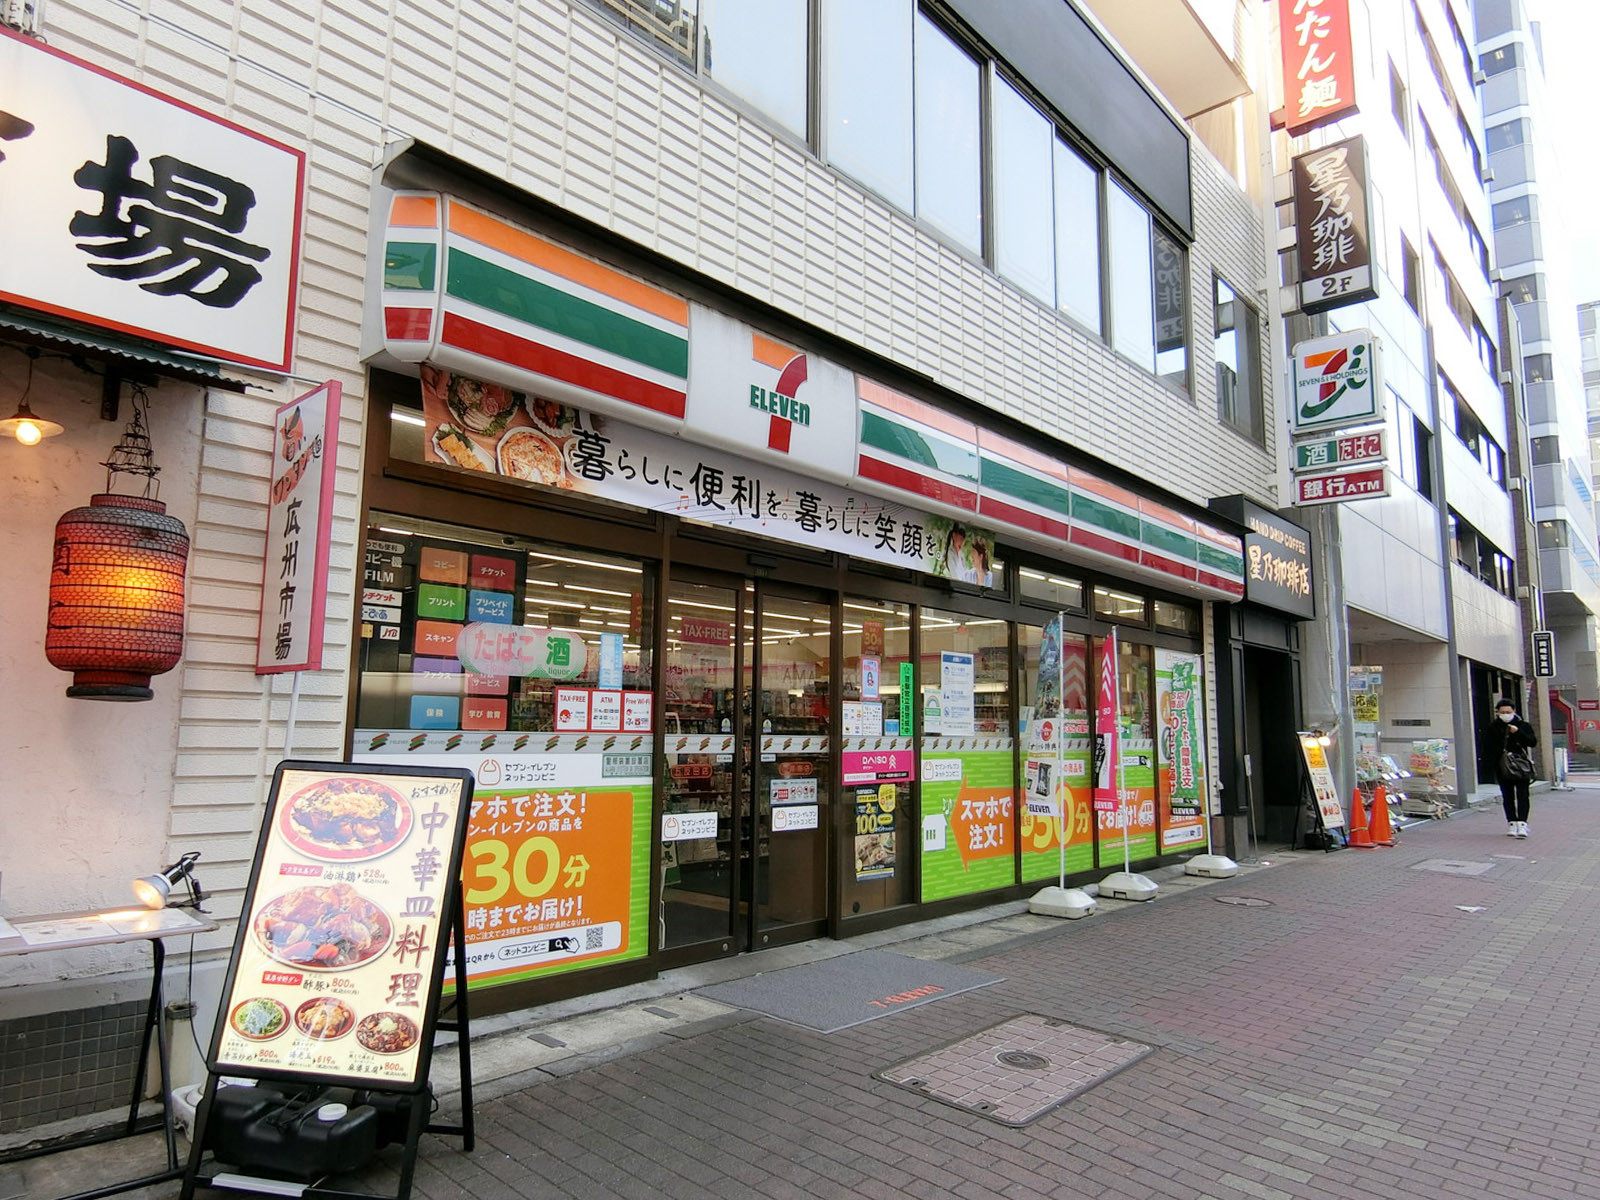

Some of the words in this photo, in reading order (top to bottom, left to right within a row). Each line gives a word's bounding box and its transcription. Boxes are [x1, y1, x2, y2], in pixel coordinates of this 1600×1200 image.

[1306, 147, 1355, 272] 星乃珈琲
[1322, 276, 1353, 298] 2F
[1330, 367, 1369, 382] HOLDINGS
[1306, 443, 1328, 466] 酒
[1340, 435, 1380, 461] たばこ
[1284, 533, 1307, 556] COFFEE
[433, 559, 456, 569] コピー
[480, 566, 506, 577] チケット
[1248, 544, 1310, 599] 星乃珈琲店
[274, 497, 304, 660] 広州市場
[428, 597, 456, 608] プリント
[475, 597, 508, 609] プリペイド
[478, 607, 505, 617] サービス
[425, 633, 455, 643] スキャン
[473, 630, 535, 663] たばこ
[545, 636, 572, 667] 酒
[548, 666, 571, 676] liquor
[472, 678, 501, 688] サービス
[862, 755, 888, 765] DAISO
[504, 773, 556, 782] ネットコンビニ
[960, 795, 1013, 821] スマホで
[385, 801, 450, 1008] 中華皿料理
